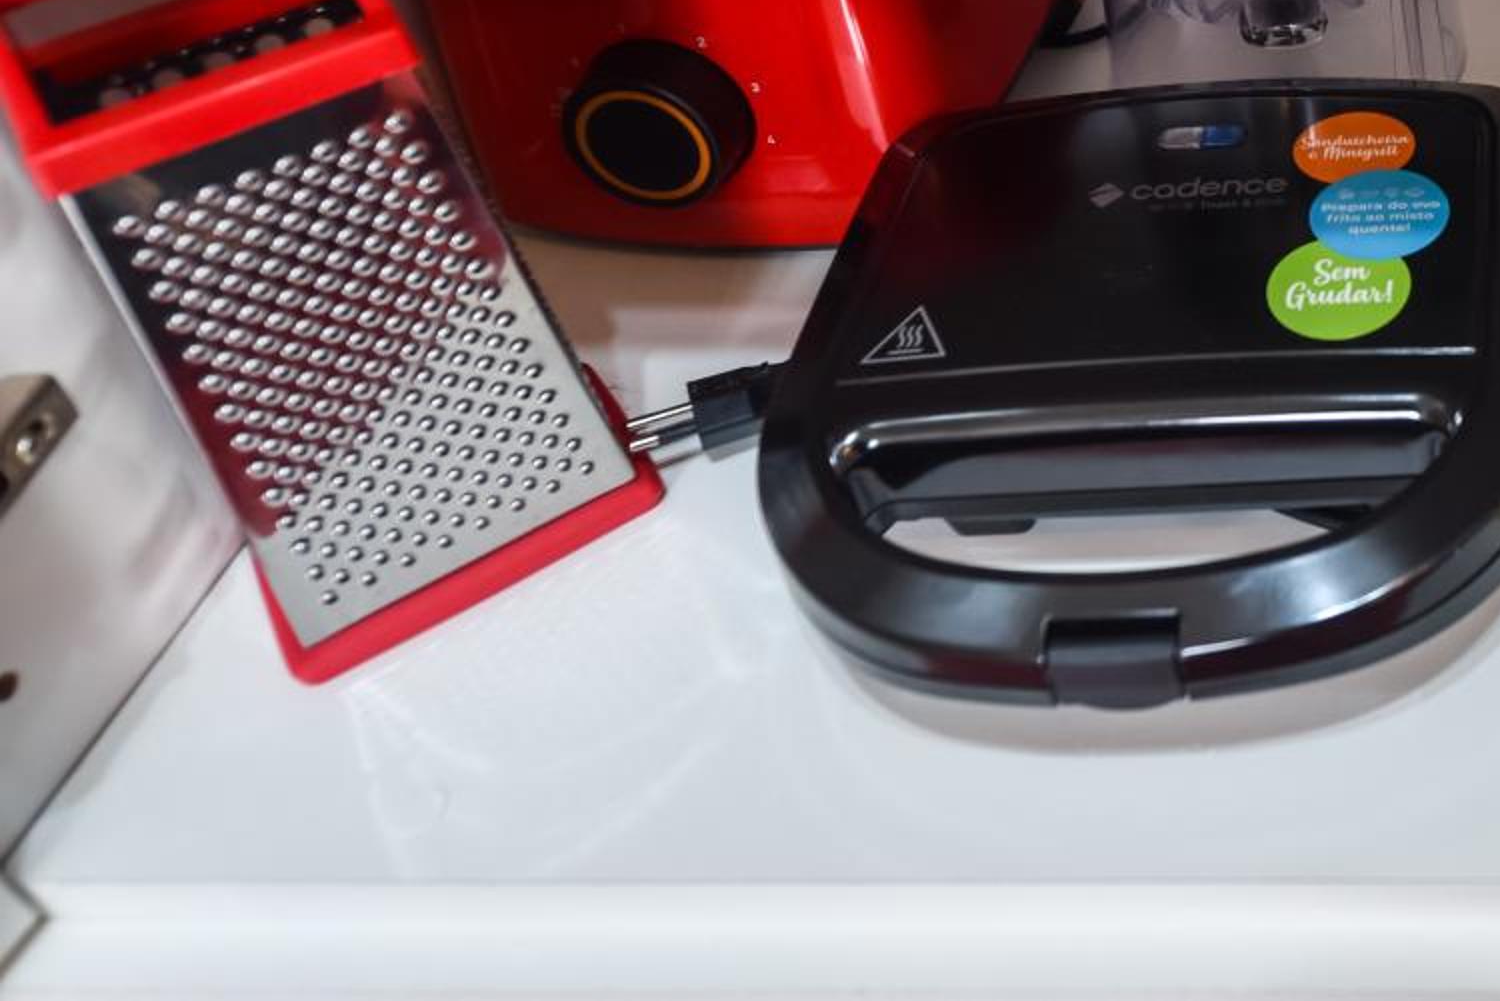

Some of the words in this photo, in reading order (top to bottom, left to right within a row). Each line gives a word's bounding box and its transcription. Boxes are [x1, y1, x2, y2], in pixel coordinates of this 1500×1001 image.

[1130, 176, 1288, 201] cadence
[1313, 258, 1371, 286] Sem
[1285, 279, 1394, 311] Grudar!
